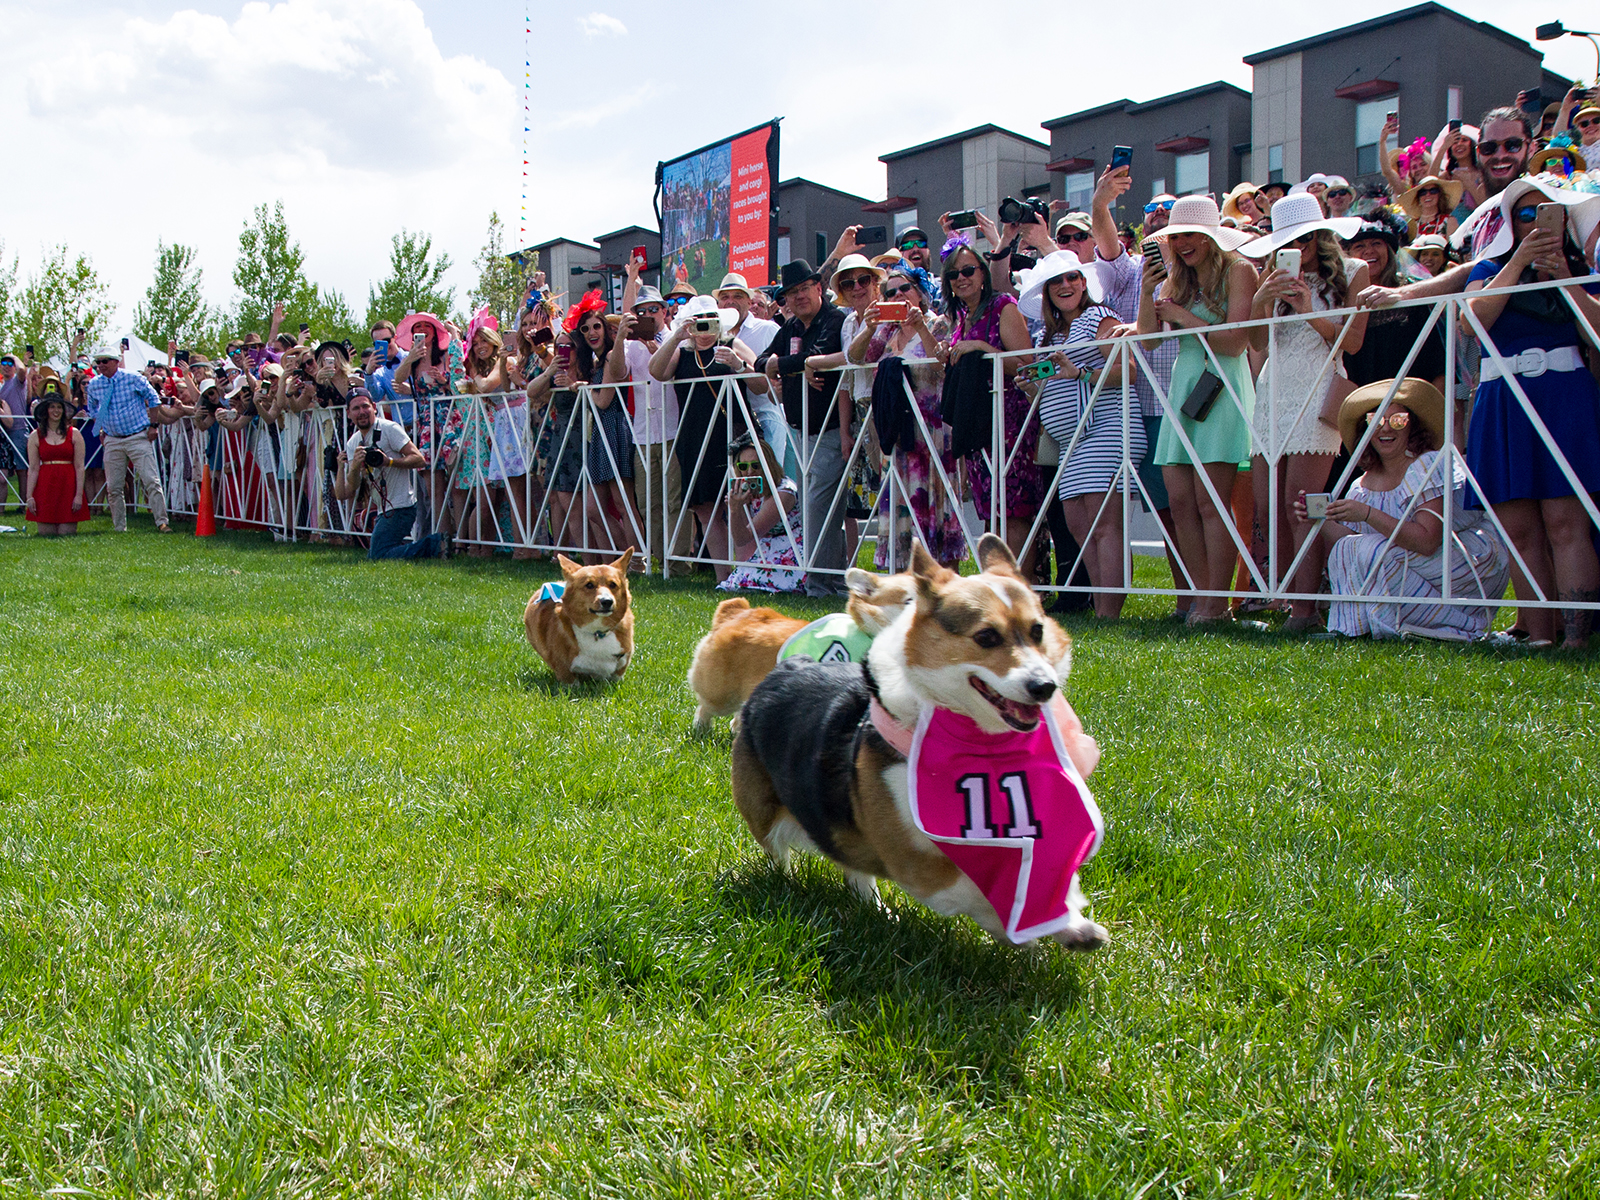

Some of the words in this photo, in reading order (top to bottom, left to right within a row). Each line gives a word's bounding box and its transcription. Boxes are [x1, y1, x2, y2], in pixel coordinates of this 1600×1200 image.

[738, 164, 748, 177] Mini
[749, 162, 764, 173] horse
[739, 180, 749, 192] and
[749, 175, 762, 189] corgi
[733, 199, 747, 209] races
[747, 191, 767, 205] brought
[738, 215, 743, 223] to
[743, 212, 754, 224] you
[754, 209, 762, 220] by:
[733, 240, 766, 255] FetchMasters
[733, 261, 744, 271] Dog
[744, 255, 765, 267] Training
[955, 770, 1043, 839] 11
